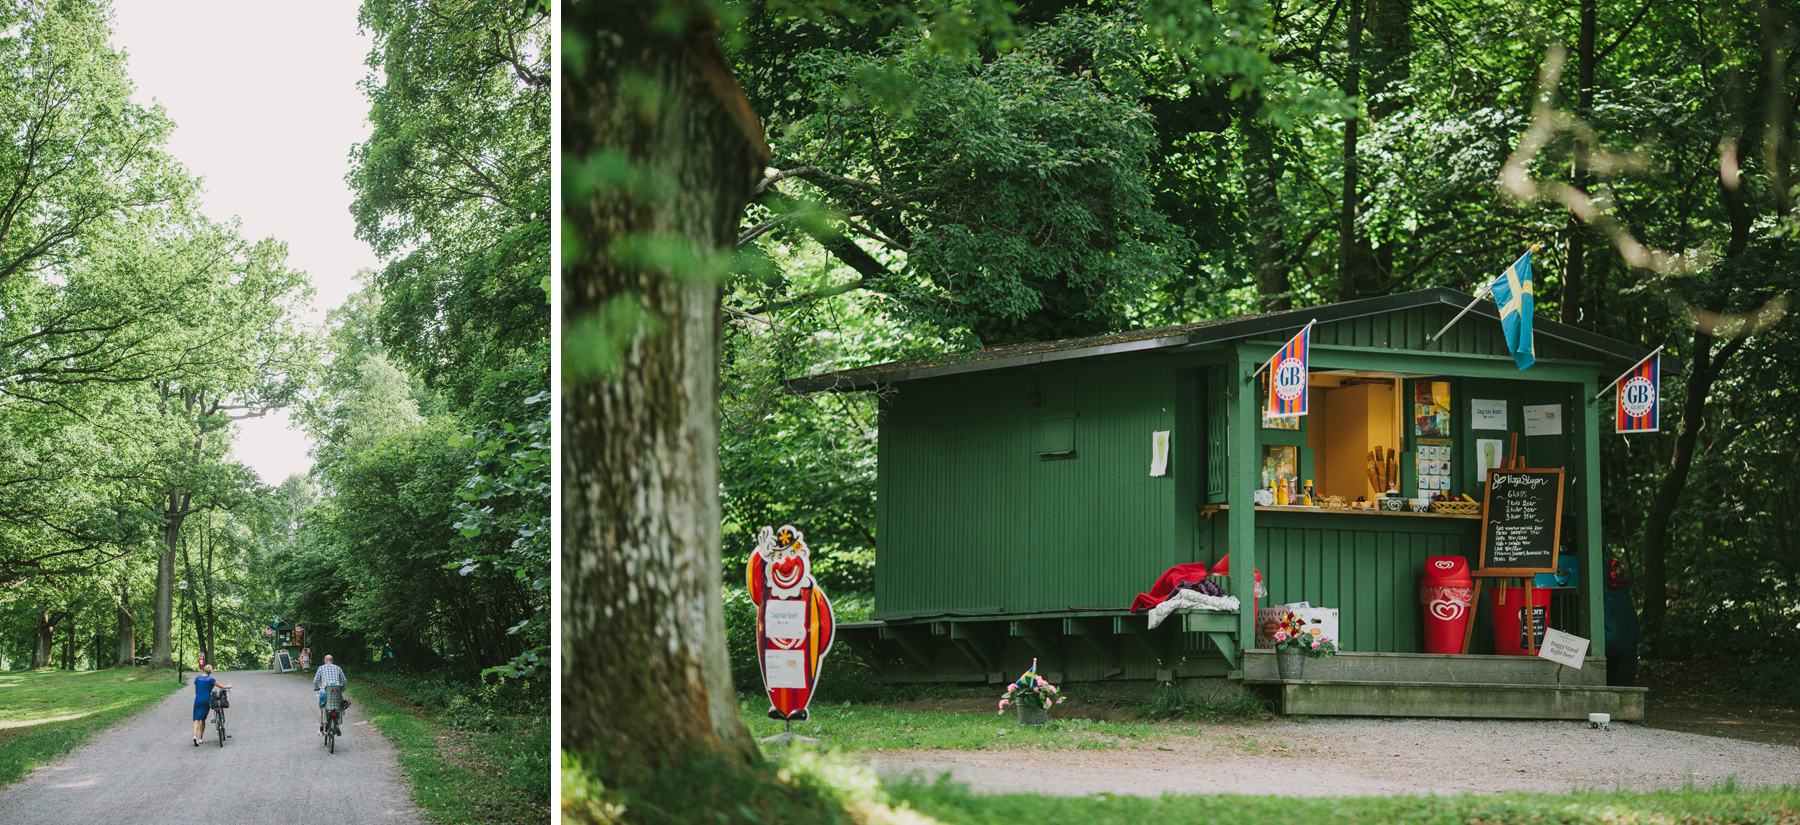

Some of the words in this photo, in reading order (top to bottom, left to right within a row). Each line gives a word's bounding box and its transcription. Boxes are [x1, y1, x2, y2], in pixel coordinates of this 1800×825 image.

[1280, 367, 1300, 386] GB
[1628, 385, 1648, 404] GB
[1476, 408, 1485, 416] Jag
[771, 611, 780, 620] Jag
[788, 611, 799, 619] kort
[1550, 647, 1562, 656] Right
[1565, 644, 1579, 654] Stand
